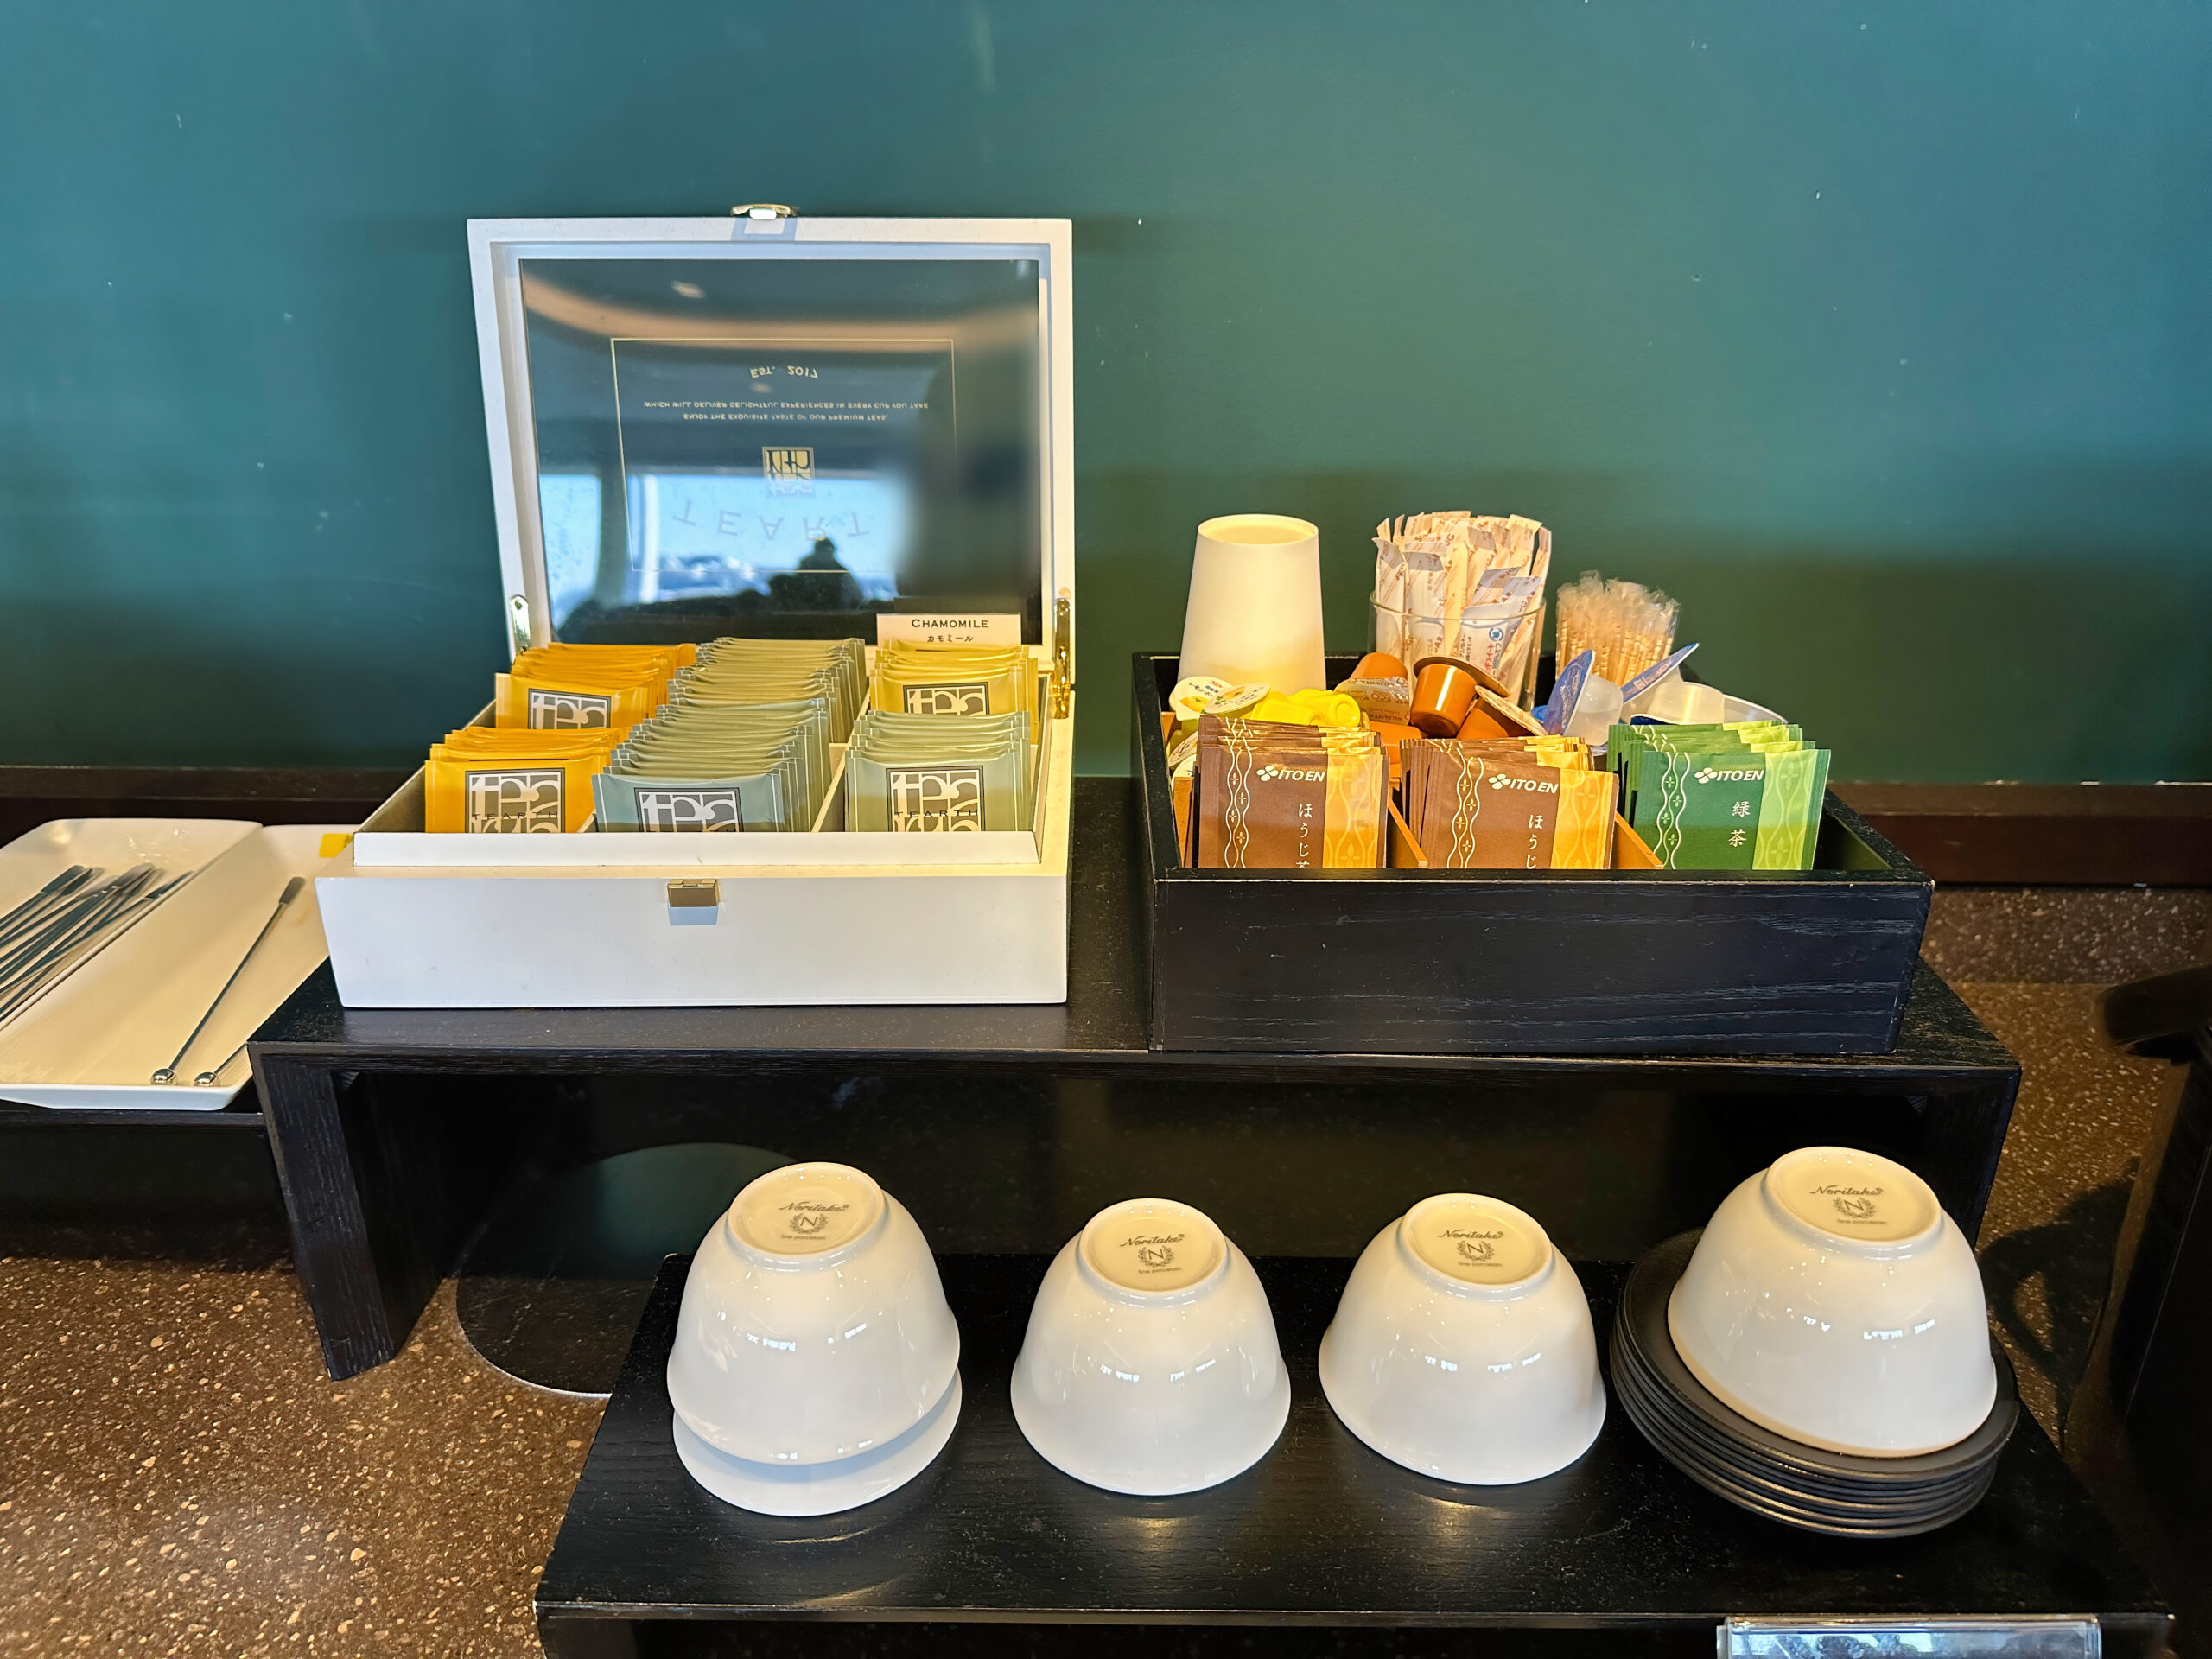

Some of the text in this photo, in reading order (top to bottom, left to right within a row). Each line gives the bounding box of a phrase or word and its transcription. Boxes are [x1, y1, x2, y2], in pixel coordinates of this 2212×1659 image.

[912, 619, 988, 628] CHAMOMILE
[927, 634, 974, 643] カモミール
[472, 811, 558, 820] TEARTH
[894, 810, 978, 818] TEARTH
[1728, 801, 1751, 848] 緑茶
[1526, 814, 1544, 869] ほうじ
[1843, 1199, 1865, 1211] N
[799, 1216, 818, 1227] N
[1467, 1243, 1484, 1254] N
[1147, 1249, 1165, 1260] N
